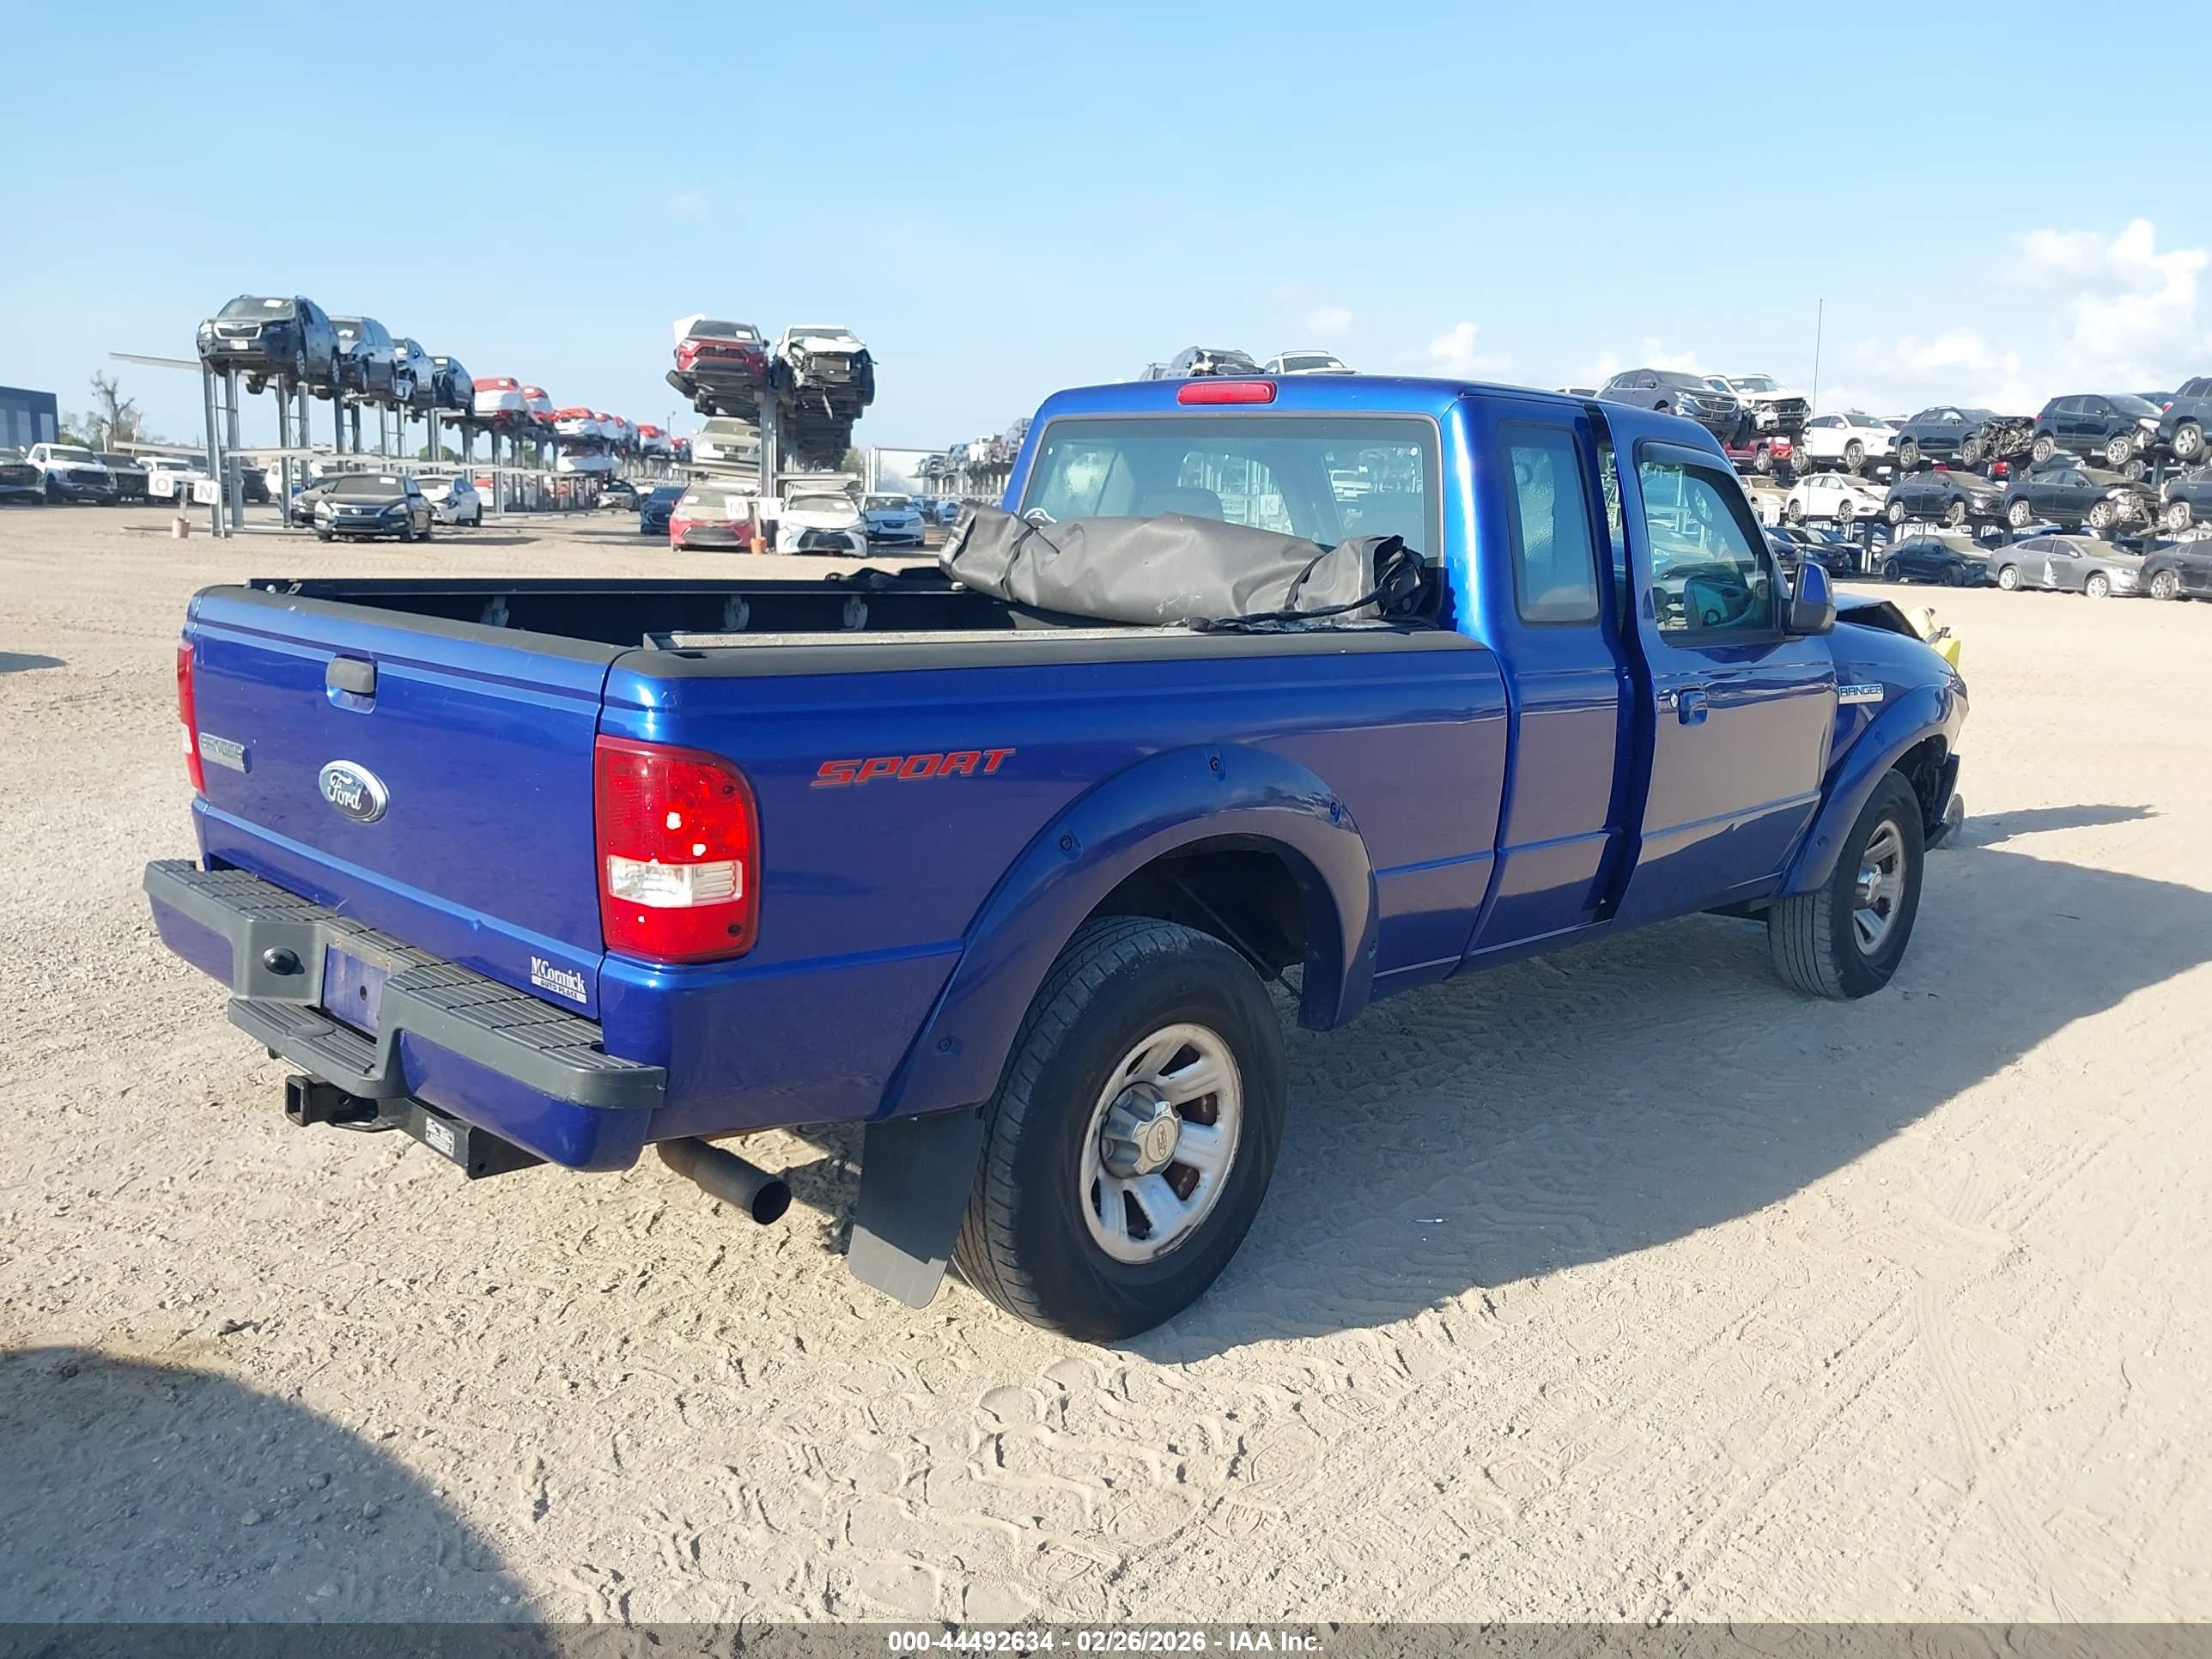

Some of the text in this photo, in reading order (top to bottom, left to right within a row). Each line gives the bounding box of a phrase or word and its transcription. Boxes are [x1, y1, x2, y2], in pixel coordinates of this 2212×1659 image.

[199, 484, 214, 500] N
[730, 501, 745, 515] M
[1265, 498, 1275, 511] K
[1839, 685, 1882, 696] RANGER
[811, 748, 1016, 789] SPORT
[328, 772, 362, 810] Ford
[540, 980, 578, 999] AUTO PLACE
